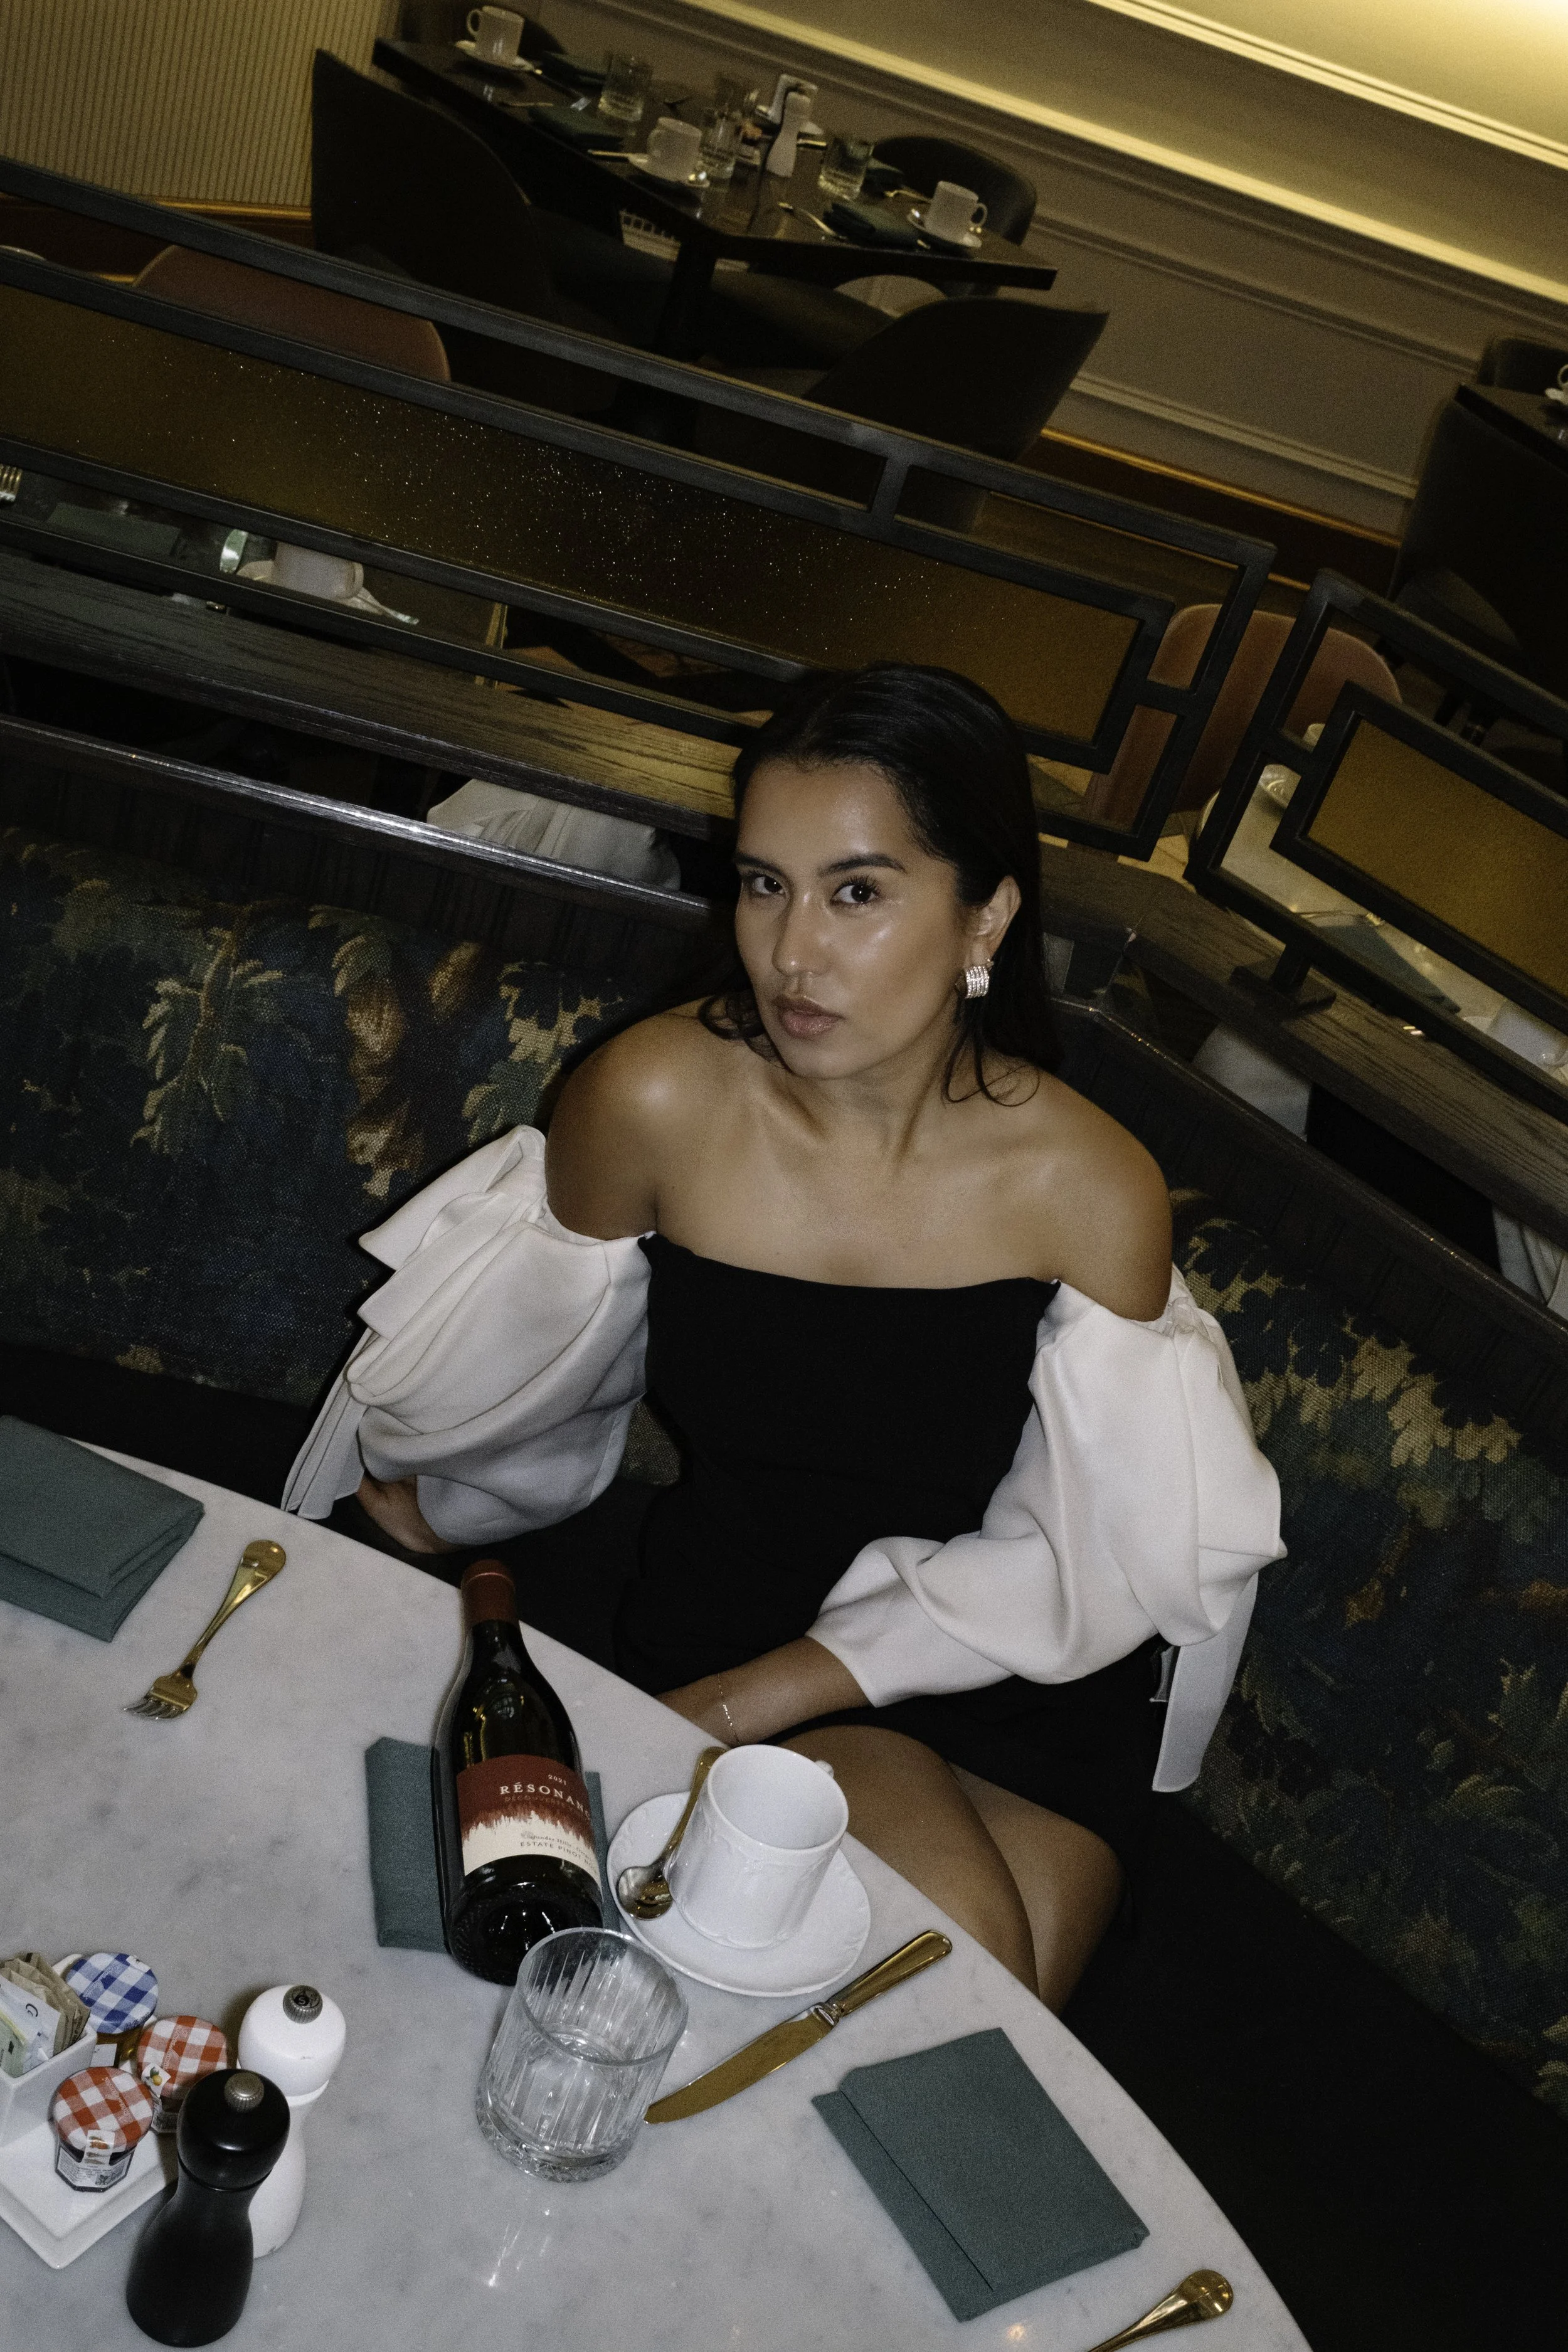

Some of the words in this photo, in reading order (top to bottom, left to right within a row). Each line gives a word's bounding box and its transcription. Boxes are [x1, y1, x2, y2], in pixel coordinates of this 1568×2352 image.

[548, 1774, 567, 1786] 2021
[558, 1846, 582, 1860] PINOT
[298, 1996, 306, 2005] S
